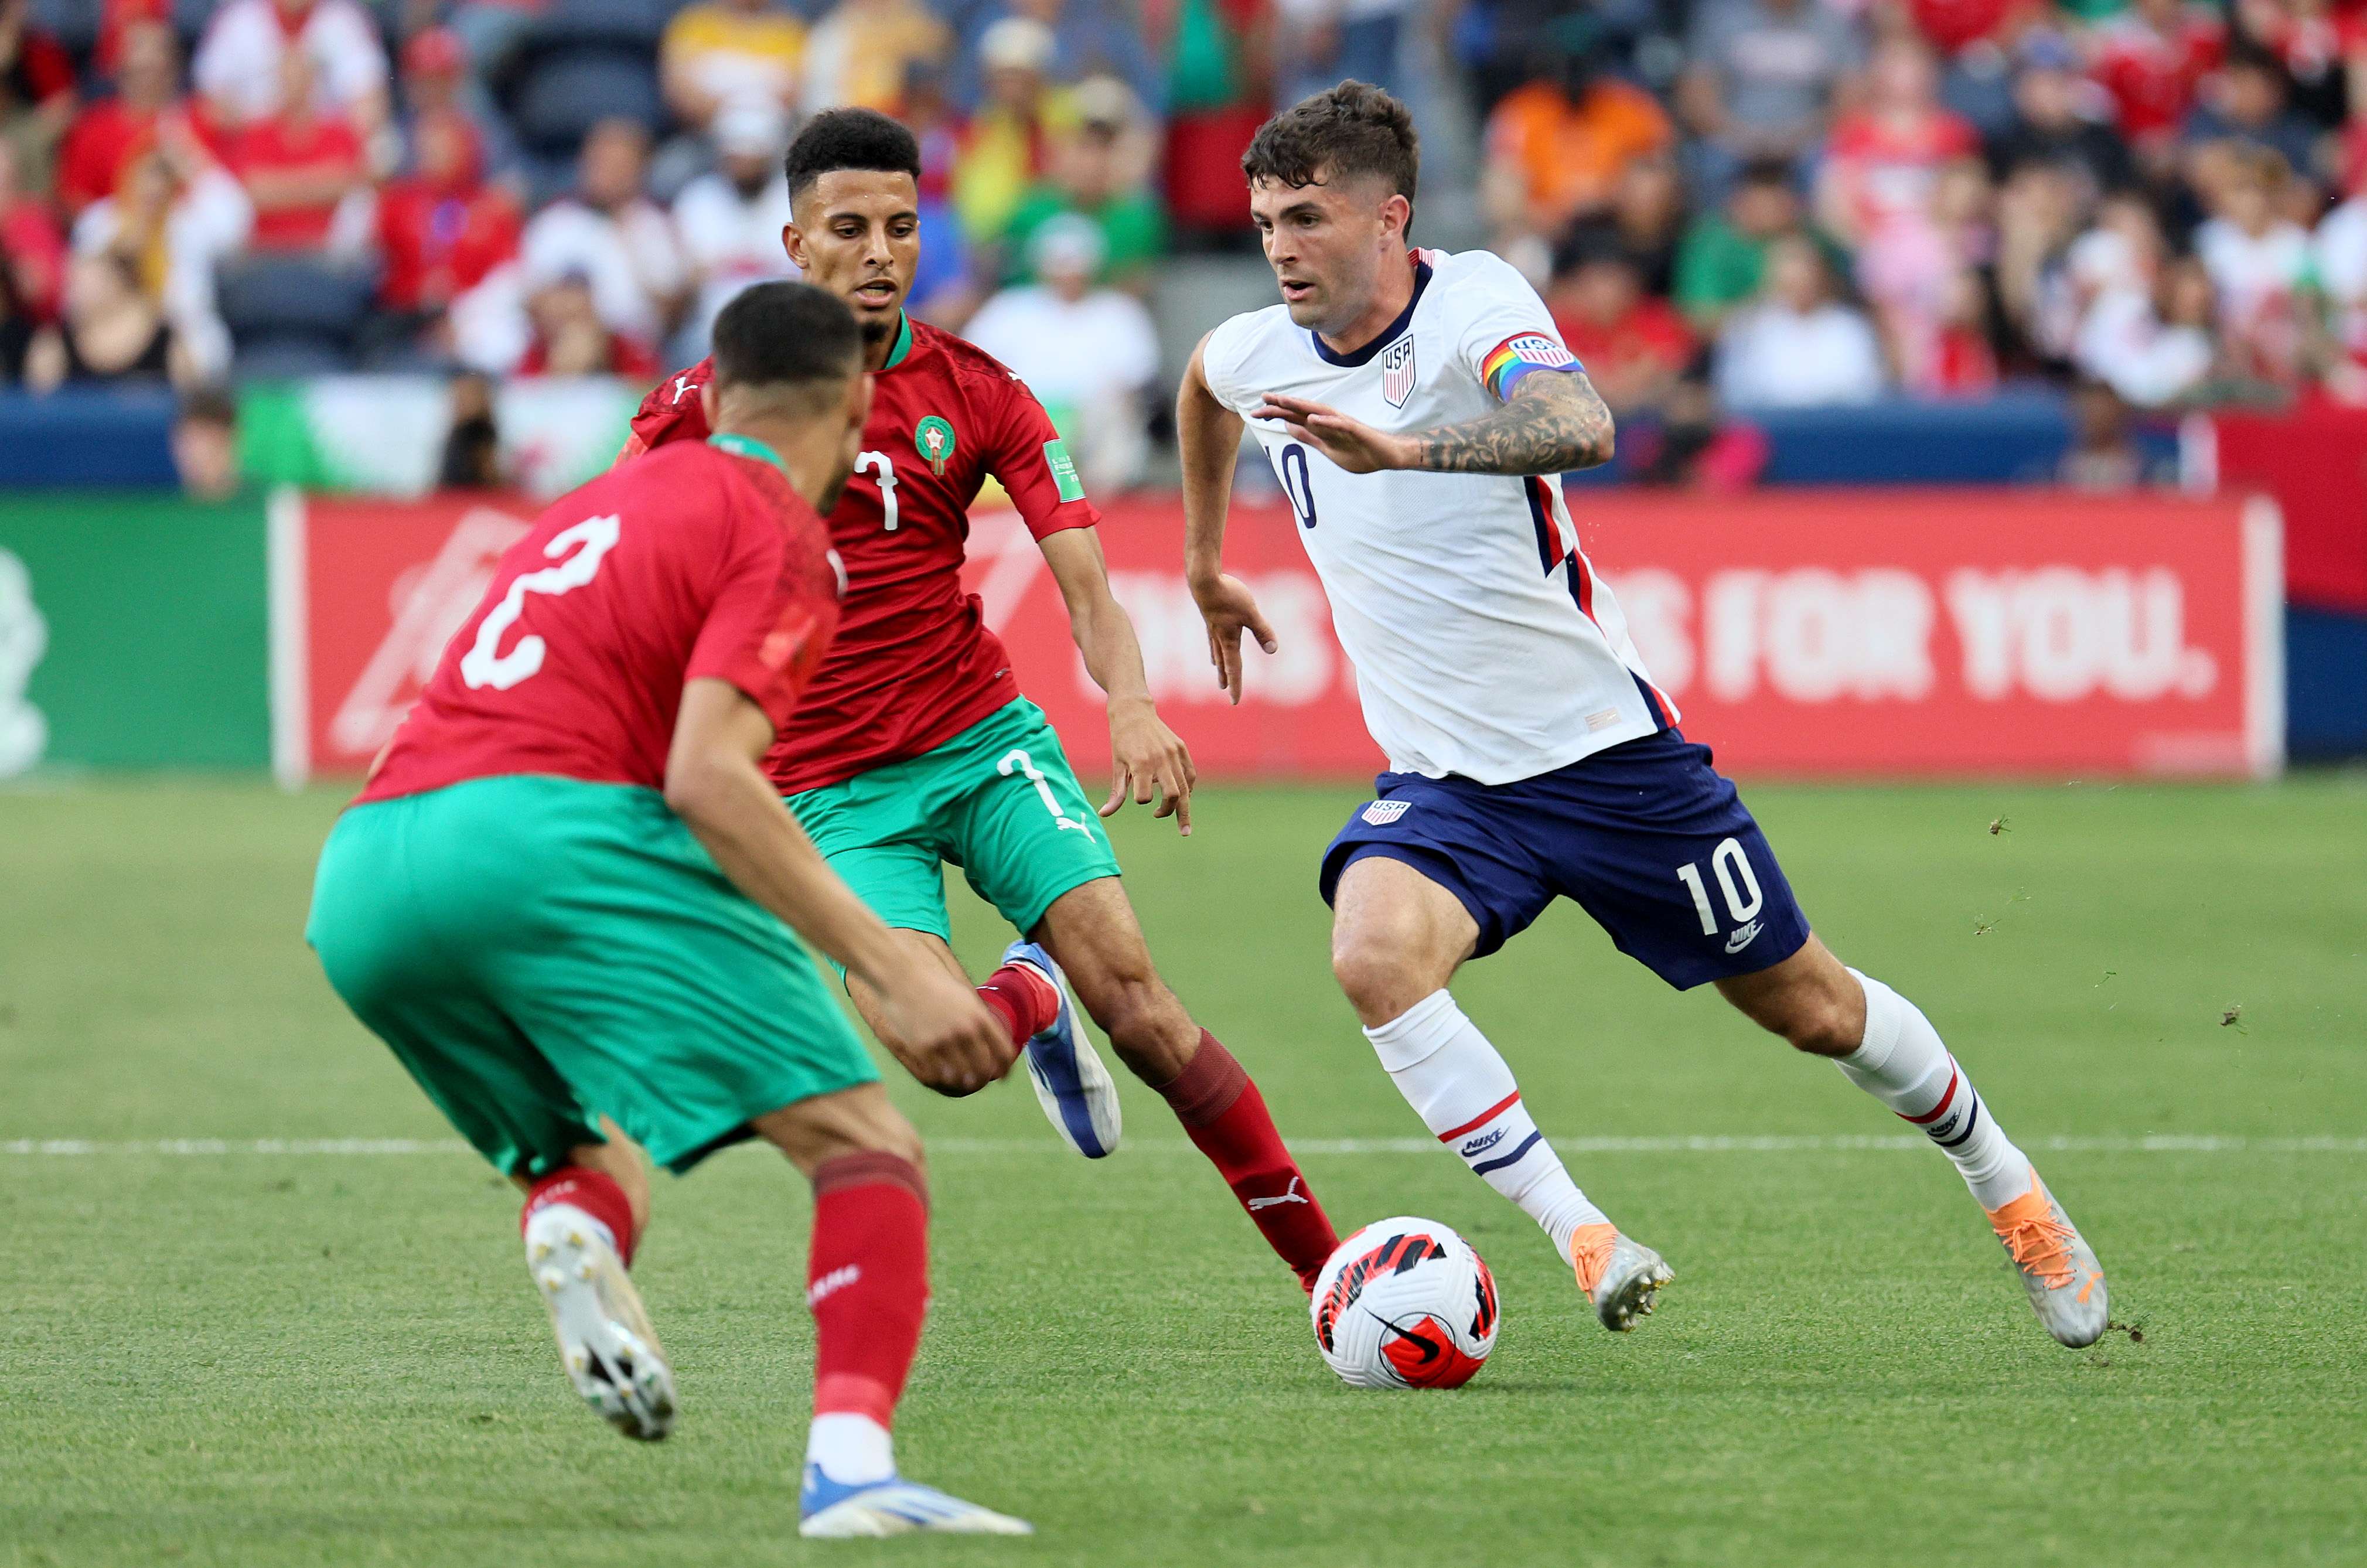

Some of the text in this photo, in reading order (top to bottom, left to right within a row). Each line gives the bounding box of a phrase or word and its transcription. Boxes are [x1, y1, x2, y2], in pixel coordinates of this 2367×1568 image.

[1386, 341, 1410, 370] USA
[854, 451, 899, 531] 7
[1265, 444, 1317, 529] 0
[460, 513, 620, 690] 2
[1704, 567, 1935, 701] FOR
[1946, 566, 2218, 701] YOU.
[997, 749, 1065, 817] 7
[1373, 802, 1407, 811] USA
[1676, 837, 1763, 936] 10
[1730, 919, 1757, 945] NIKE
[1466, 1127, 1502, 1150] NIKE
